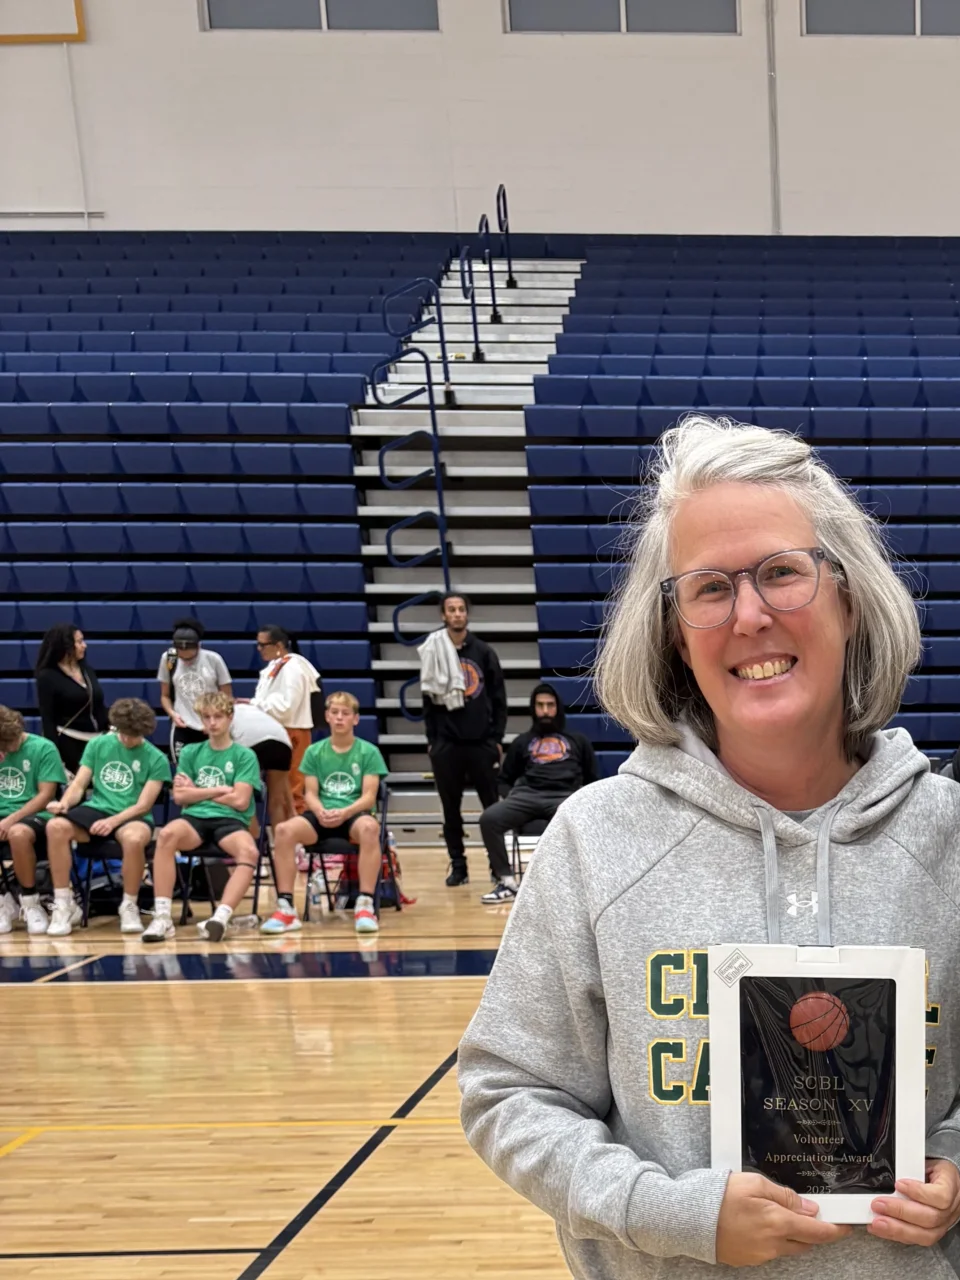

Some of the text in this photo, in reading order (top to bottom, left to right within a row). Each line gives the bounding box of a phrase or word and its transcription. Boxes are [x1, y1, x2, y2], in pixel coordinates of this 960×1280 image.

[793, 1075, 845, 1090] SCBL
[763, 1097, 874, 1112] SEASON XV
[793, 1134, 845, 1145] Volunteer
[765, 1152, 873, 1163] Appreciation Award
[806, 1185, 831, 1194] 2025
